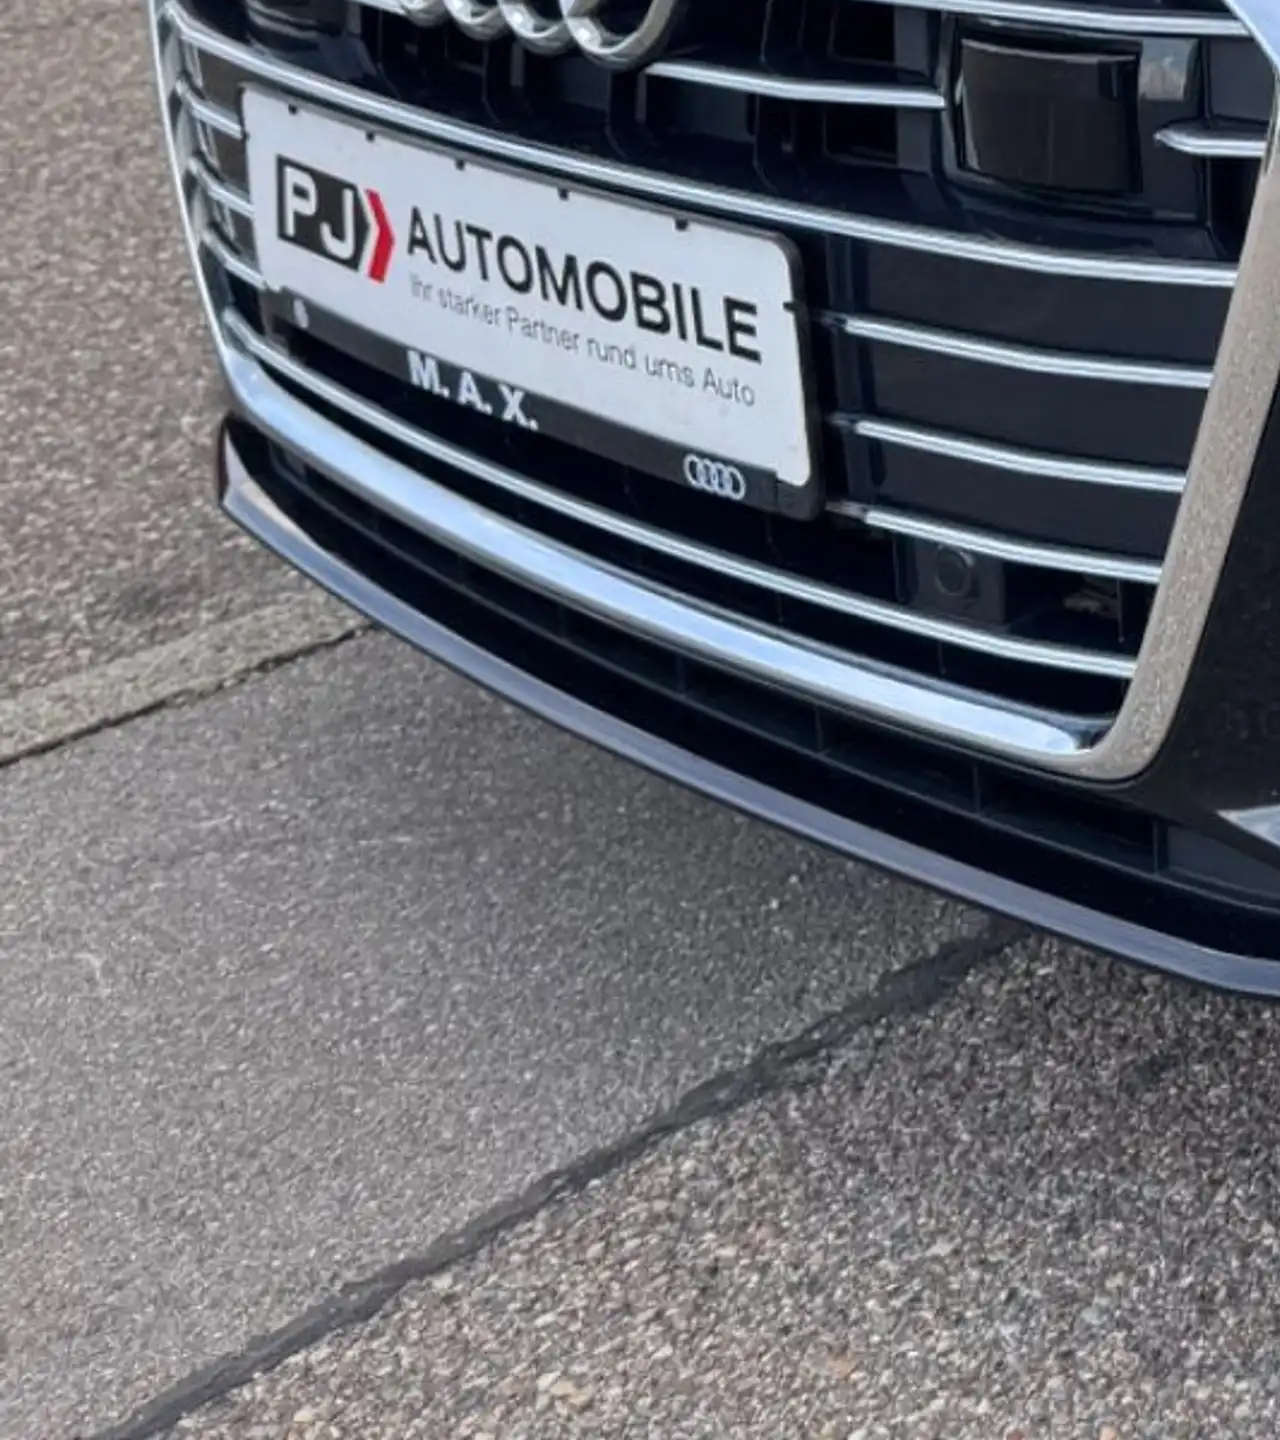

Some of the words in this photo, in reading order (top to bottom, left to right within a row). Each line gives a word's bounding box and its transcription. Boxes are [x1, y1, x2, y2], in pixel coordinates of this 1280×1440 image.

[284, 165, 355, 261] PJ
[407, 205, 762, 365] AUTOMOBILE
[410, 271, 433, 303] Ihr
[437, 285, 501, 328] starker
[506, 305, 580, 352] Partner
[586, 337, 637, 370] rund
[645, 353, 695, 388] ums
[703, 366, 757, 408] Auto
